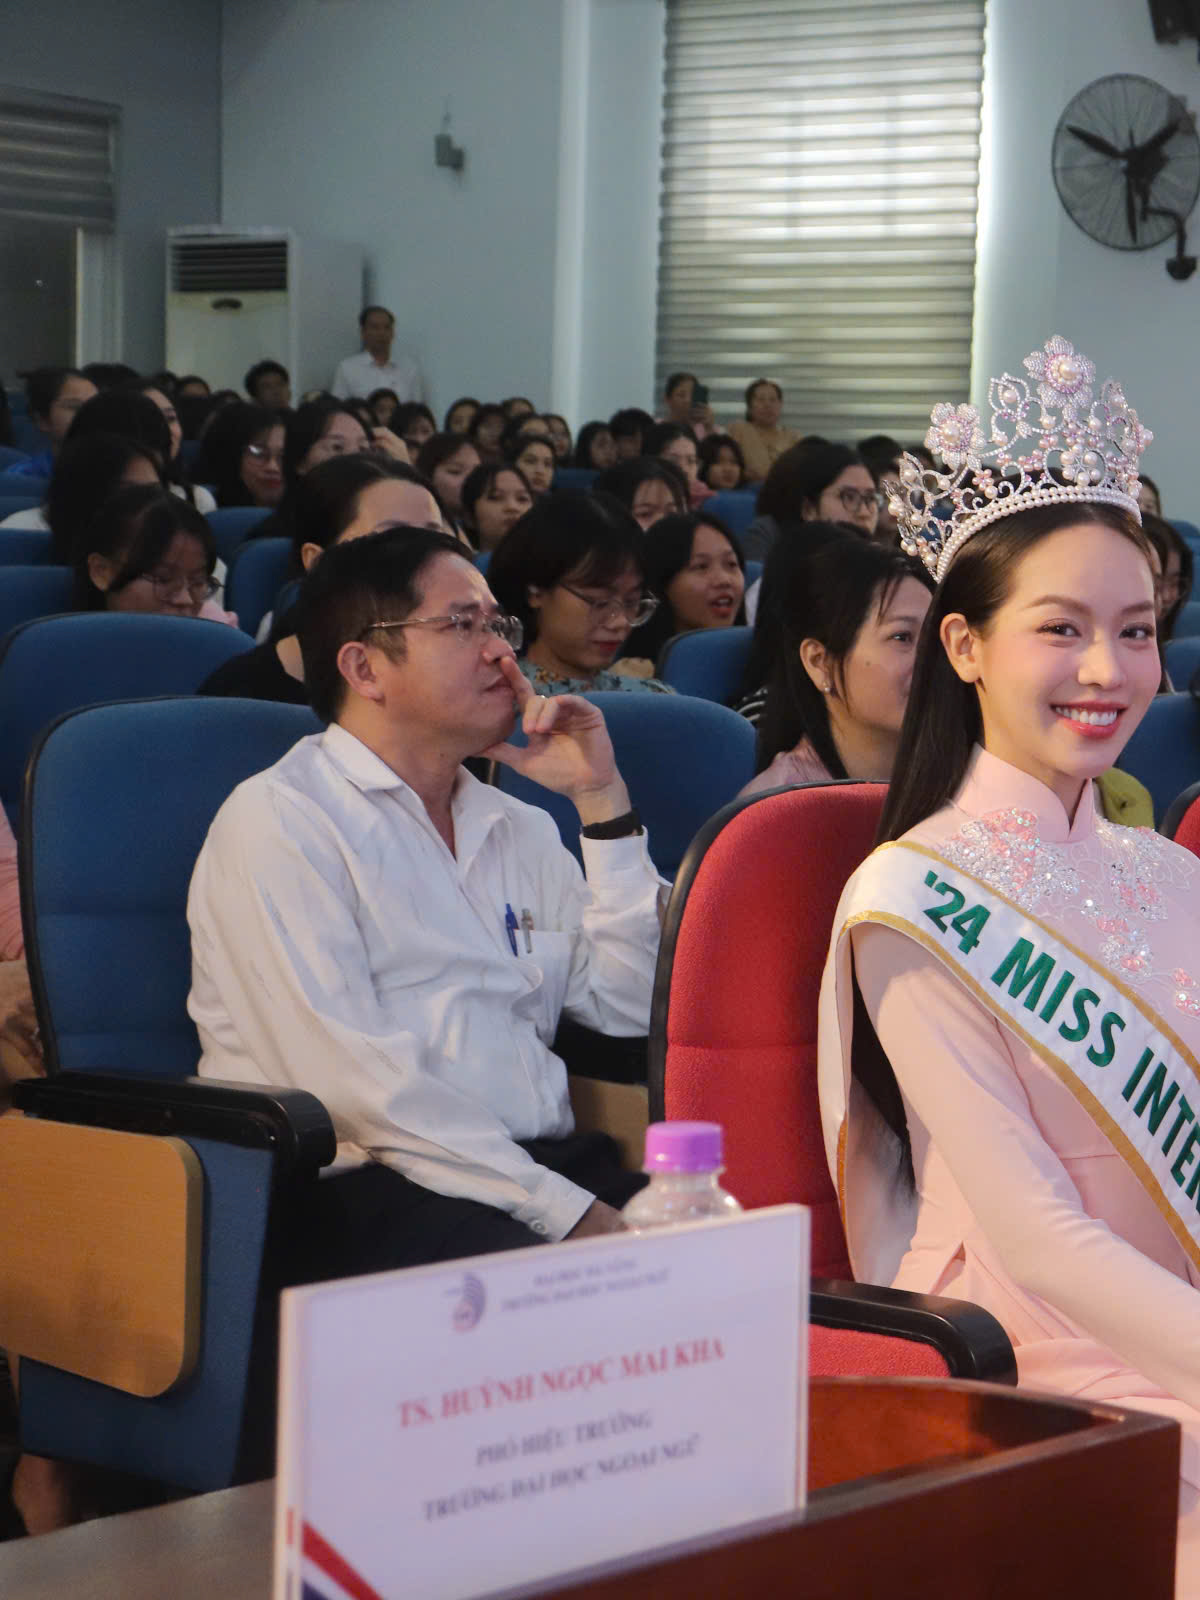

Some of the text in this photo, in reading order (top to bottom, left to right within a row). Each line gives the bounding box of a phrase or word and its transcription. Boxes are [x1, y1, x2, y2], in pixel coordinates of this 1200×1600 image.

[923, 870, 991, 955] '24
[990, 937, 1126, 1067] MISS
[619, 1347, 669, 1378] MAI
[672, 1337, 726, 1368] KHA
